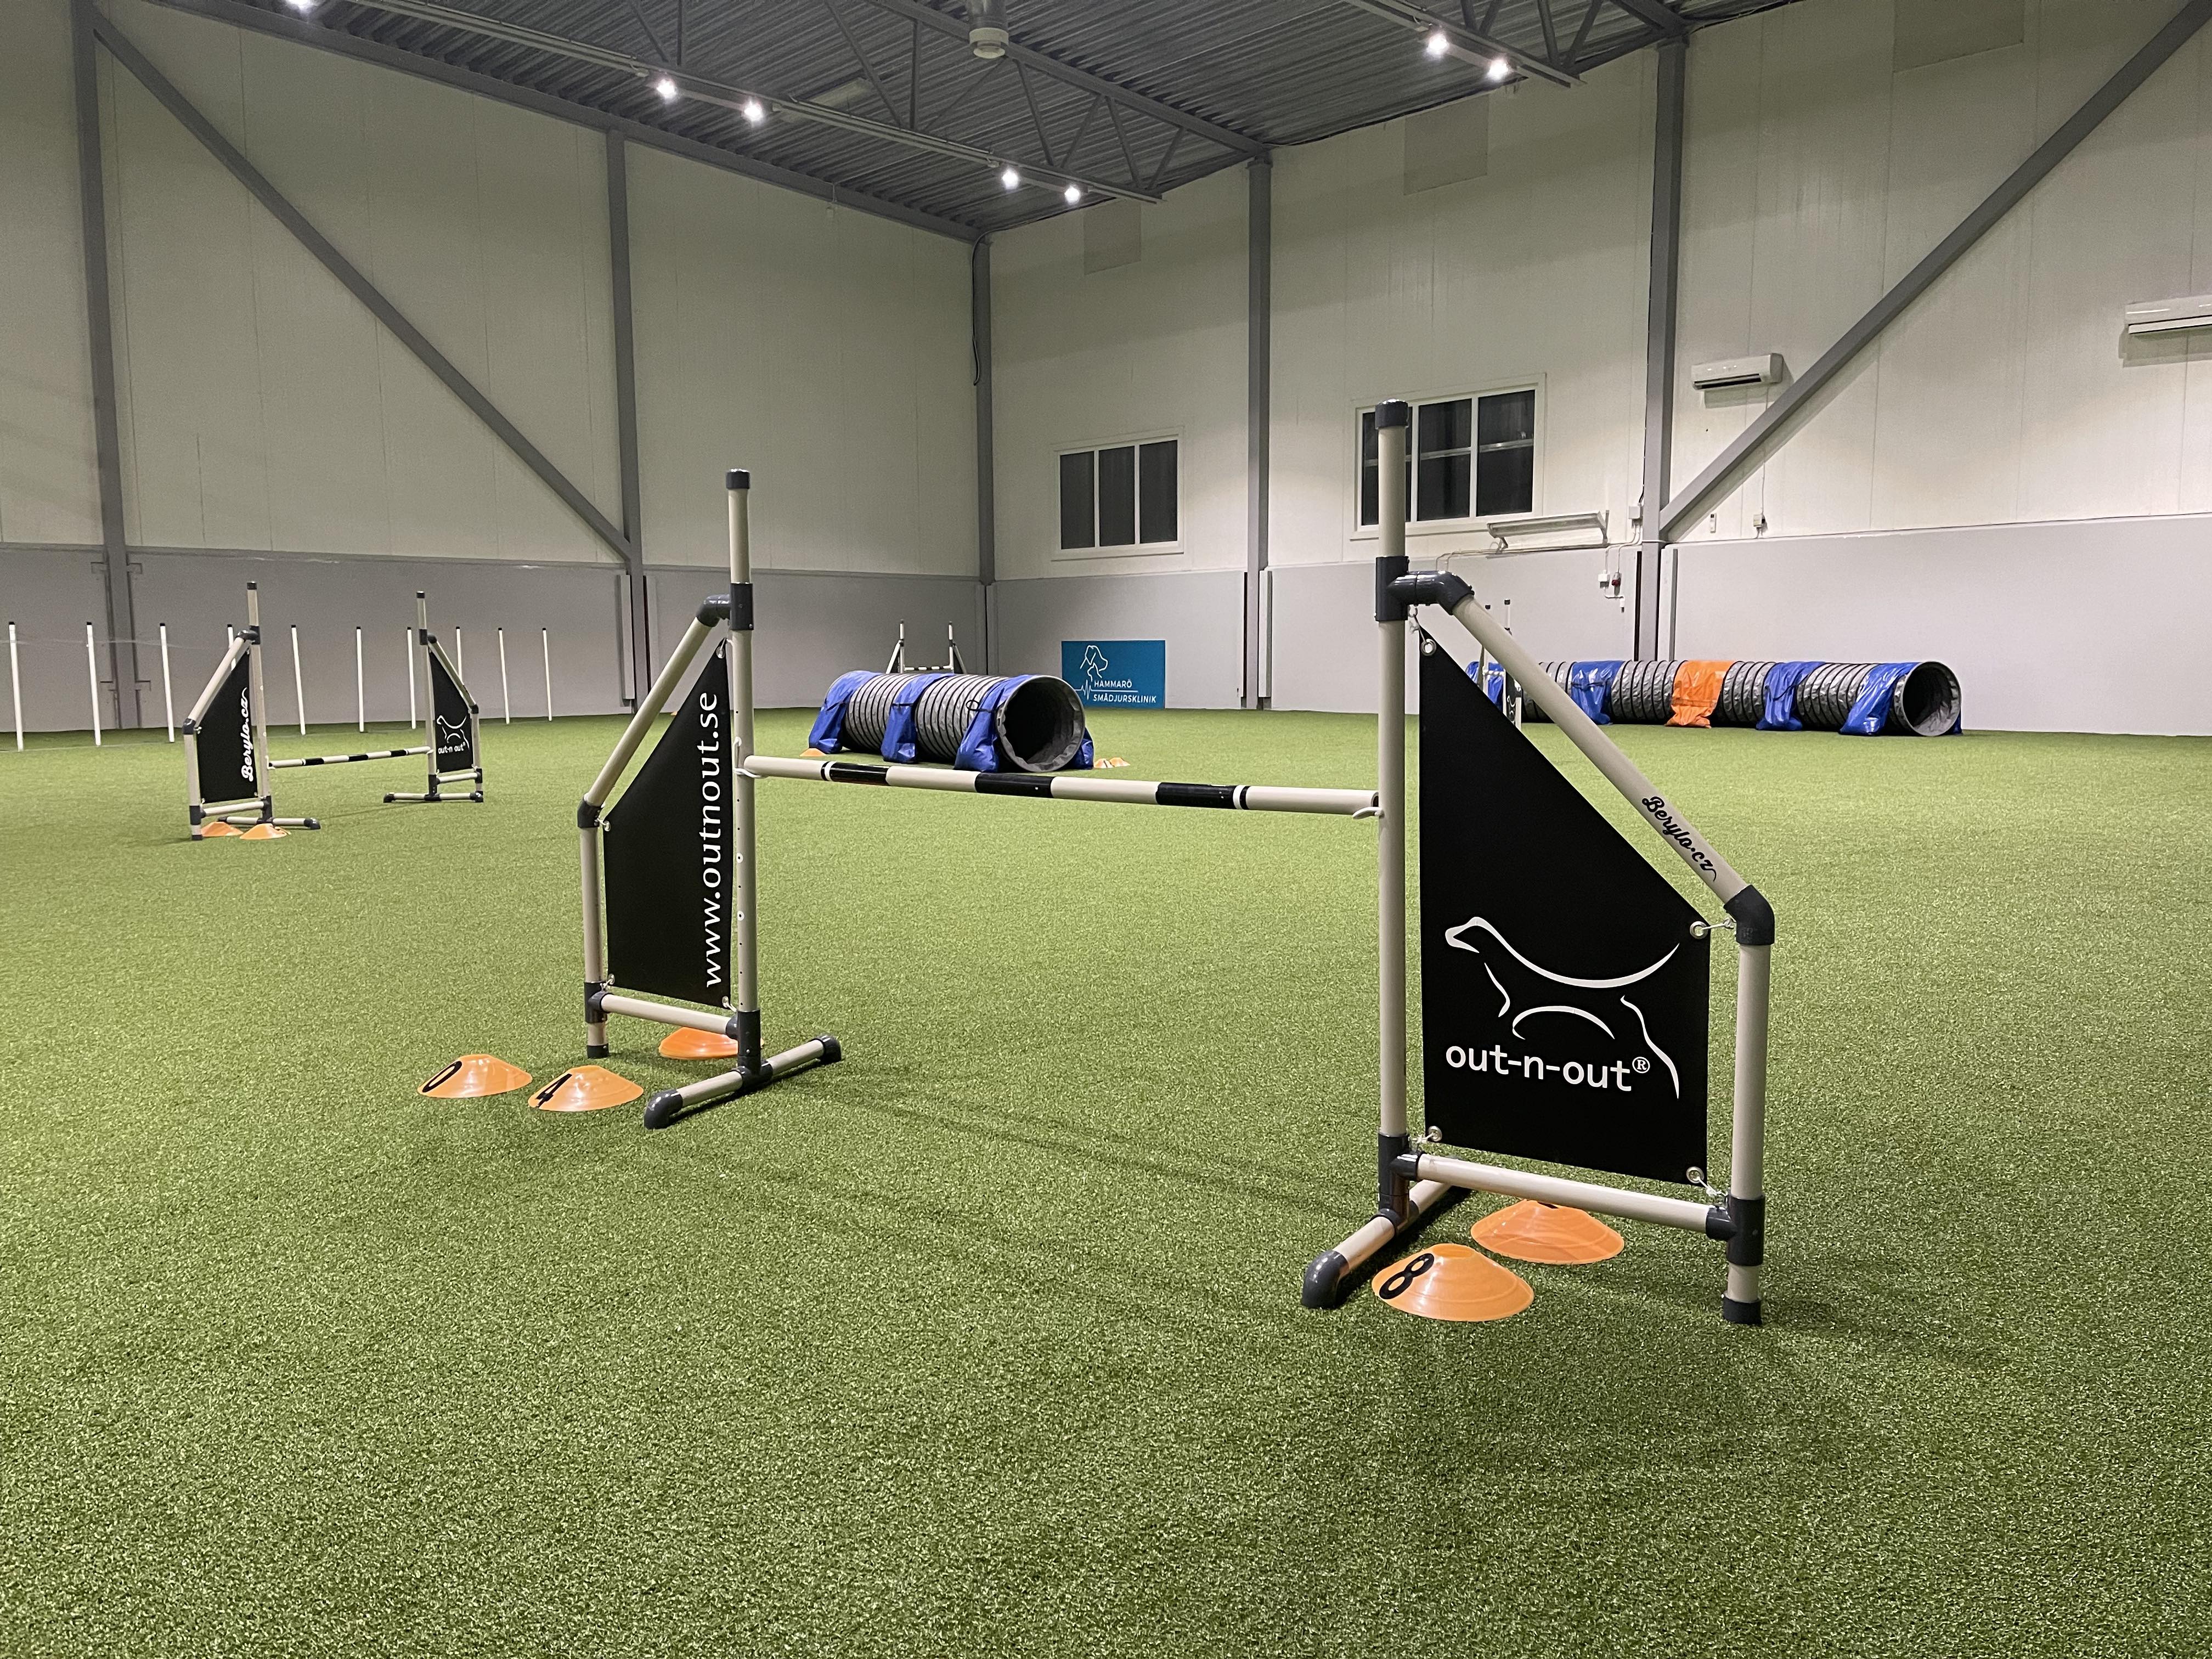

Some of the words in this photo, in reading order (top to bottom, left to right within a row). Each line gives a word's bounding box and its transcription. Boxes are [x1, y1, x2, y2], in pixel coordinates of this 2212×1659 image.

[1093, 693, 1156, 703] SMÅDJURSKLINIK
[1094, 679, 1132, 689] HAMMARÖ
[240, 687, 253, 782] Berylo.cz
[697, 692, 722, 988] www.outnout.se
[1641, 796, 1717, 882] Berylo.cz
[535, 1073, 573, 1108] 4
[1379, 1252, 1435, 1300] 8
